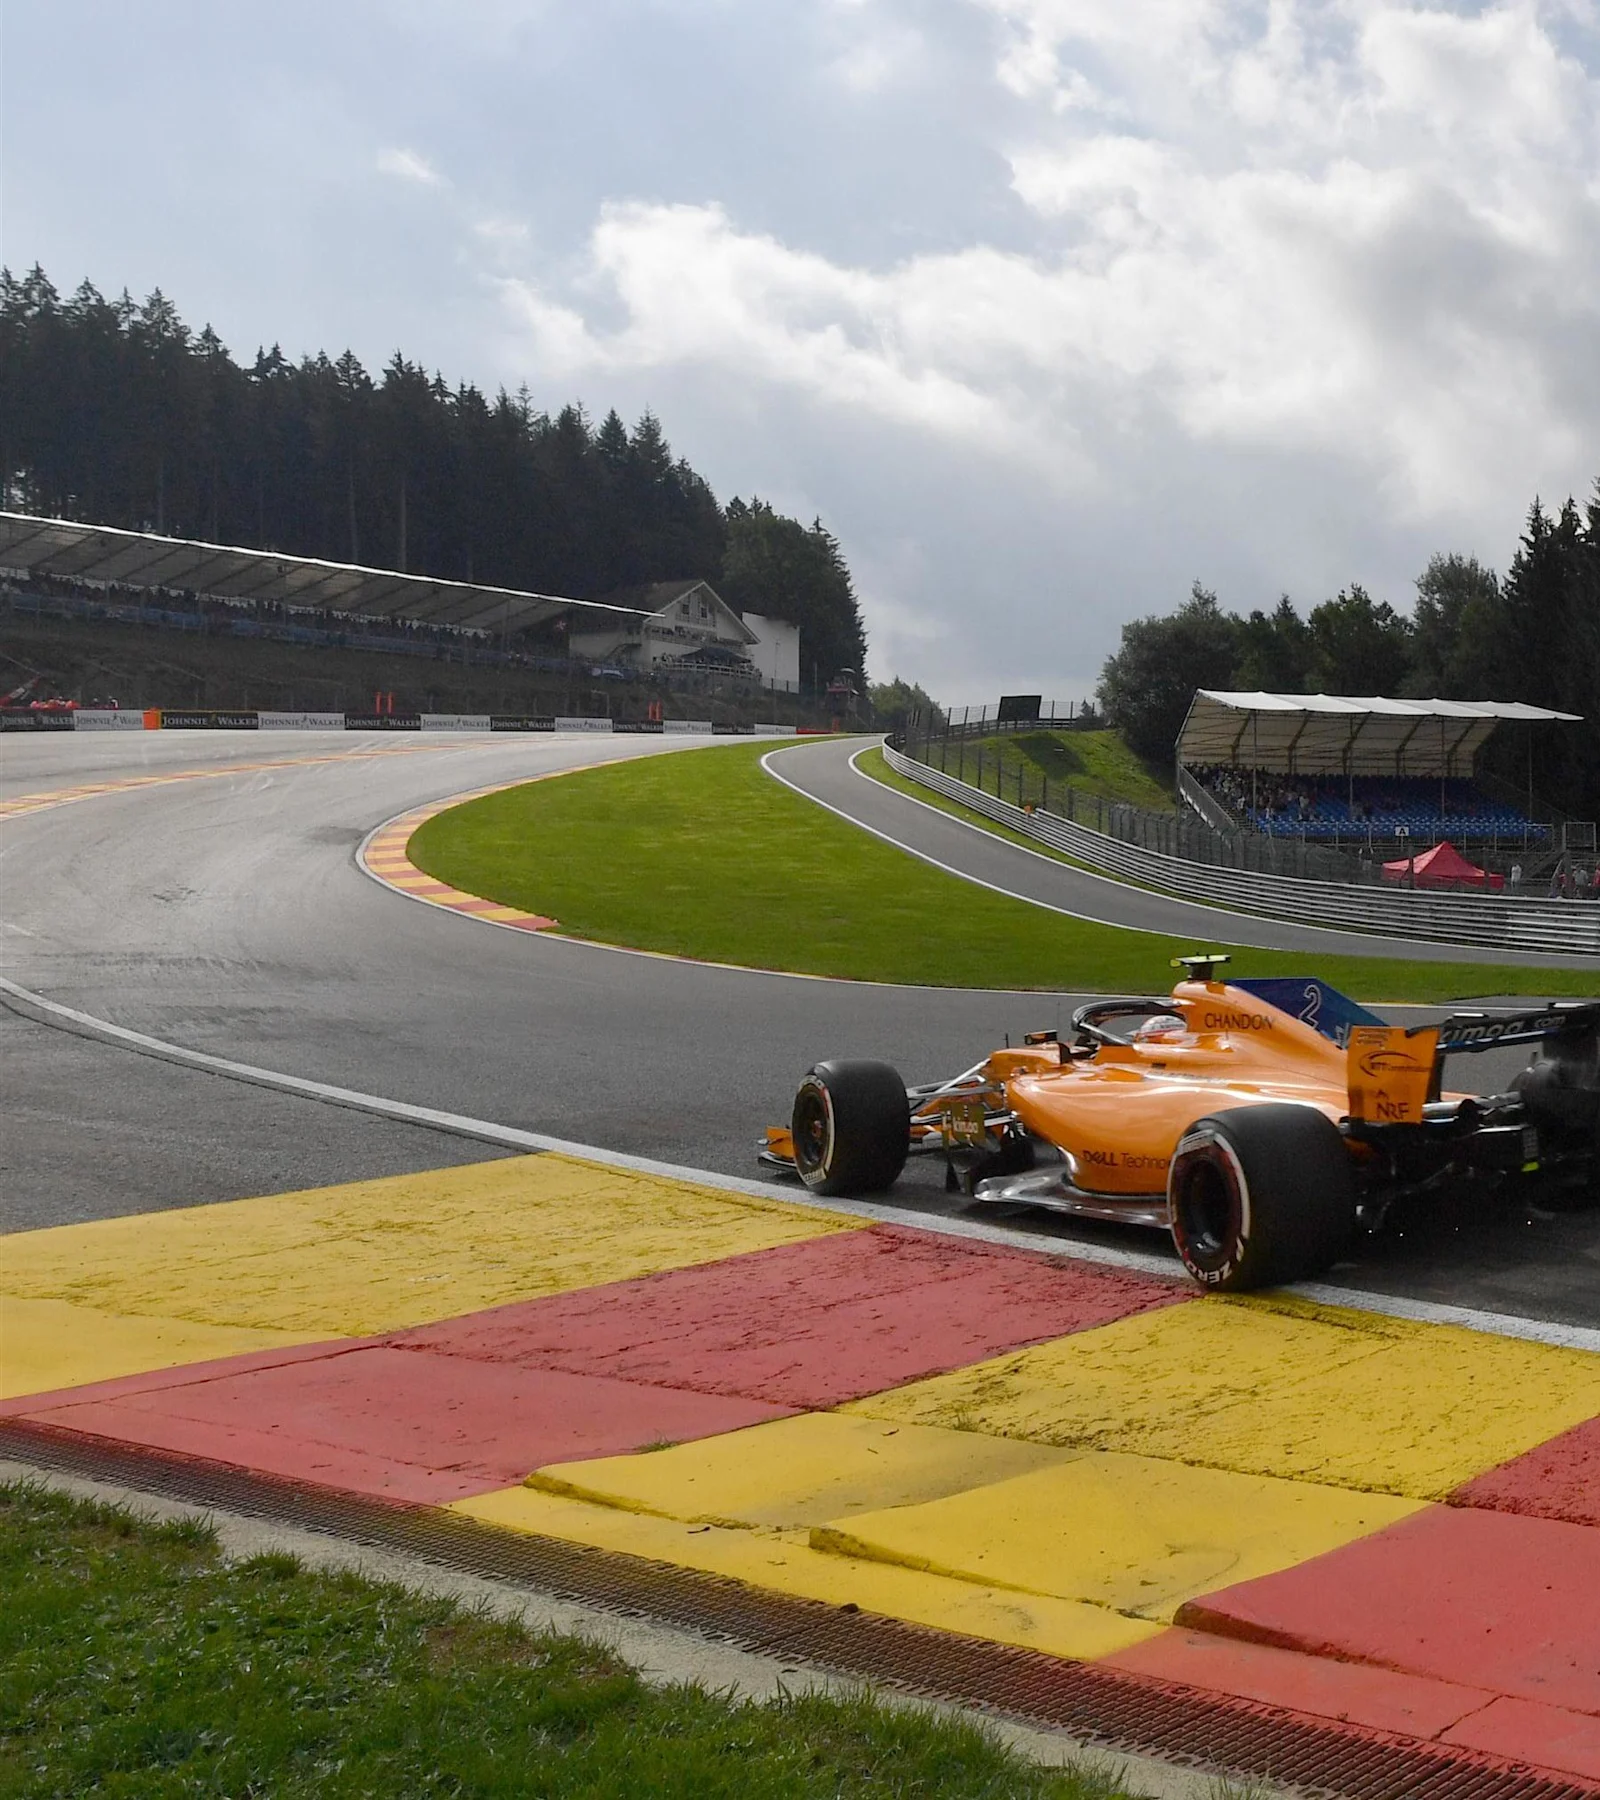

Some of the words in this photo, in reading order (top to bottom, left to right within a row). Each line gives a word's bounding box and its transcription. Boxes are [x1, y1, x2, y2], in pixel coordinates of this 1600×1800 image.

[163, 715, 208, 727] JOHNNIE
[217, 716, 258, 726] WALKER
[260, 716, 300, 727] JOHNNIE
[309, 717, 344, 726] WALKER
[346, 717, 381, 728] JOHNNIE
[389, 718, 421, 727] WALKER
[1299, 984, 1322, 1030] 2
[1204, 1013, 1275, 1031] CHANDON
[1376, 1102, 1409, 1120] NRF
[1082, 1149, 1119, 1167] DELL
[1186, 1260, 1233, 1284] ZERO
